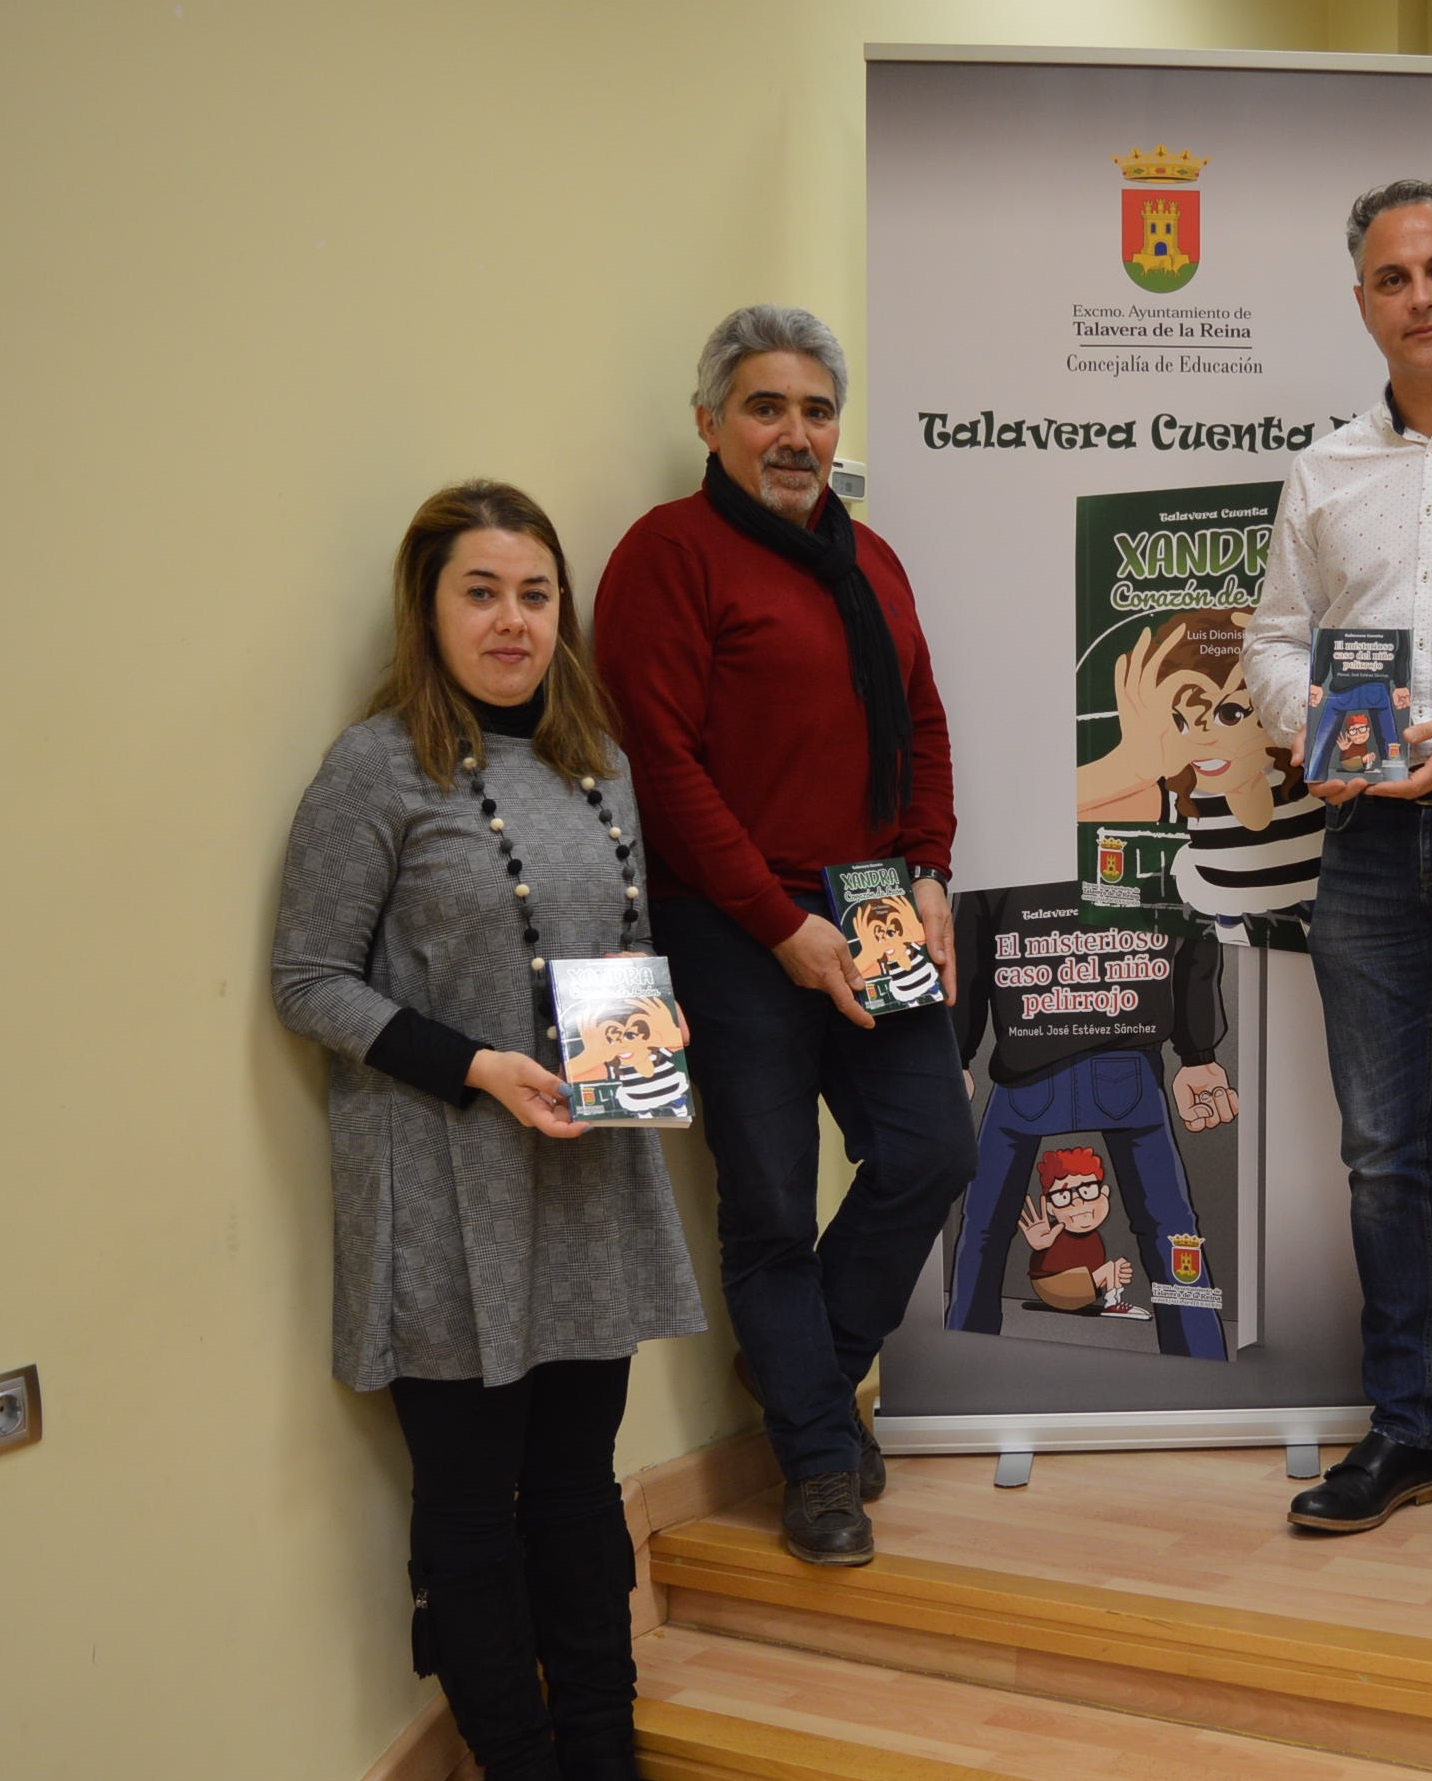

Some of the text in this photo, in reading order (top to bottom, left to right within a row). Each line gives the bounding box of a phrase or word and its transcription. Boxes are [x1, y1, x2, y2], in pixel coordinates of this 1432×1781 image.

[1072, 304, 1252, 321] Excmo. Ayuntamiento de
[1073, 321, 1251, 339] Talavera de la Reina
[1066, 354, 1264, 377] Concejalía de Educación
[918, 410, 1136, 452] Talavera
[1151, 414, 1316, 452] Cuenta
[1159, 507, 1269, 522] Talavera Cuenta
[1114, 525, 1274, 579] XANDR
[1110, 578, 1214, 611] Corazón
[1216, 575, 1249, 608] de
[1187, 629, 1246, 641] Luis Dionisi
[1199, 644, 1241, 658] Dégano
[839, 868, 900, 890] XANDRA
[995, 928, 1168, 959] El misterioso
[995, 954, 1170, 987] caso del niño
[1022, 985, 1138, 1019] pelirrojo
[1008, 1023, 1156, 1037] Manuel José Estévez Sánchez
